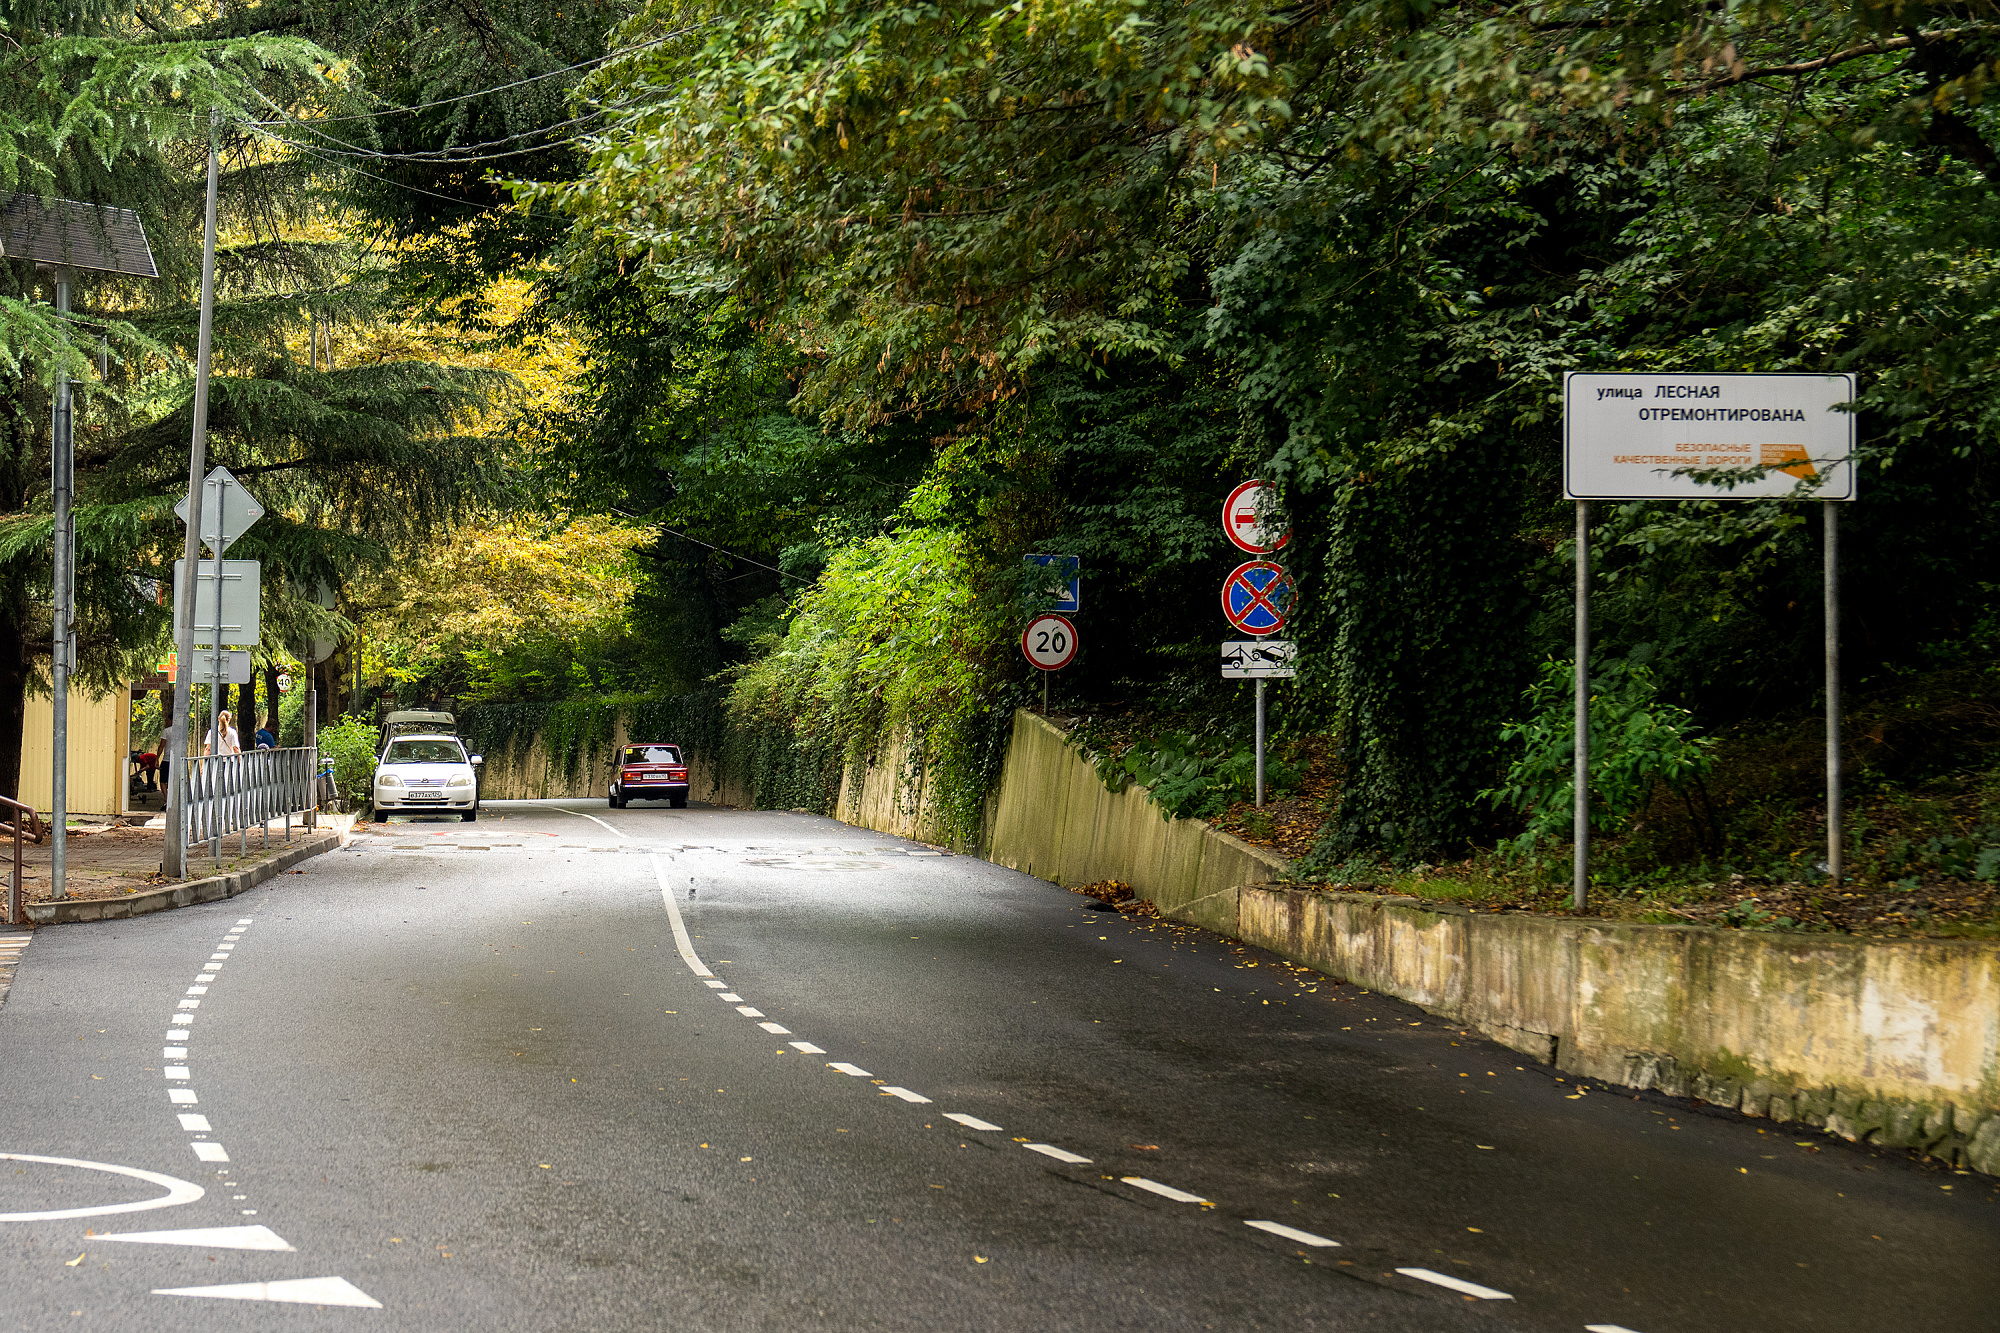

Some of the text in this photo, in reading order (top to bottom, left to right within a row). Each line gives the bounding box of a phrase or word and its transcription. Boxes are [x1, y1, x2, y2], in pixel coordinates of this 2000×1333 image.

[1597, 385, 1720, 400] улица ЛЕСНАЯ
[1639, 408, 1805, 422] ОТРЕМОНТИРОВАНА
[1675, 443, 1751, 453] БЕЗОПАСНЫЕ
[1613, 455, 1701, 465] КАЧЕСТВЕННЫЕ
[1705, 455, 1752, 466] ДОРОГИ
[1036, 631, 1066, 653] 20
[278, 678, 290, 687] 40
